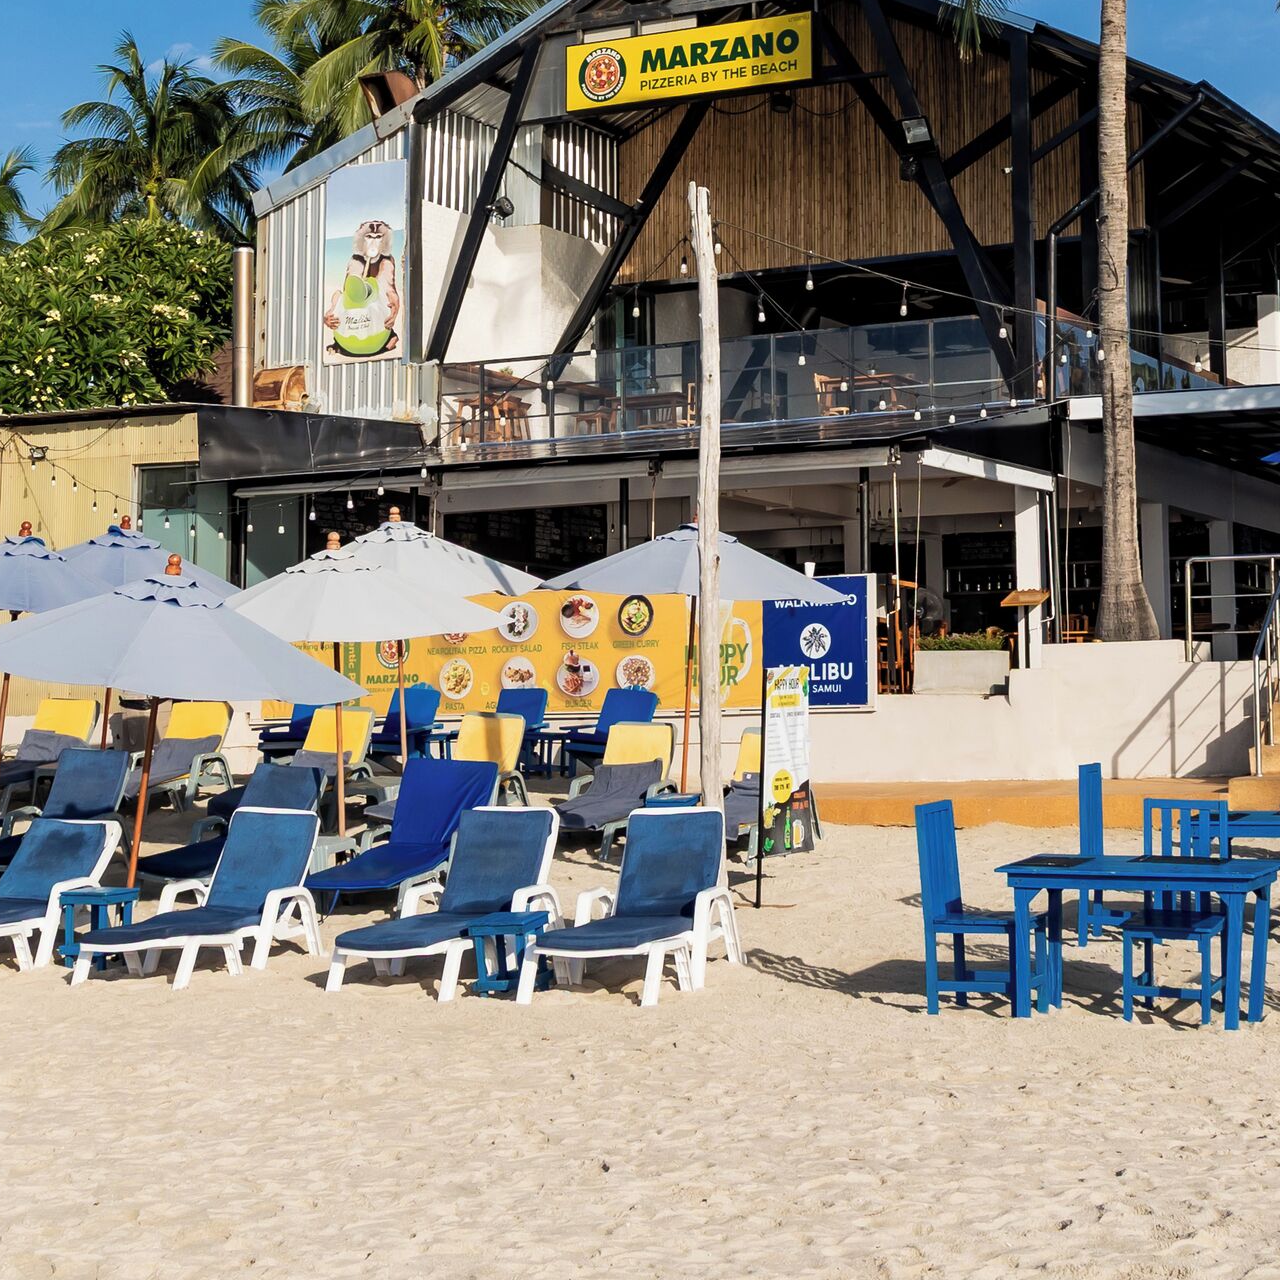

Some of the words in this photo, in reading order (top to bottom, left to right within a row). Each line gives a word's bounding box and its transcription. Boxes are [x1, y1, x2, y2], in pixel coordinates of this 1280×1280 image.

[586, 48, 621, 63] MARZANO
[640, 28, 800, 73] MARZANO
[640, 73, 697, 91] PIZZERIA
[701, 71, 718, 83] BY
[722, 66, 748, 80] THE
[751, 59, 798, 76] BEACH
[561, 642, 576, 650] FISH
[578, 641, 599, 650] STEAK
[636, 639, 660, 648] CURRY
[469, 646, 487, 655] PIZZA
[491, 645, 518, 654] ROCKET
[520, 644, 542, 653] SALAD
[685, 643, 749, 665] HPY
[778, 662, 853, 681] LIBU
[812, 684, 842, 694] SAMUI
[445, 702, 465, 710] PASTA
[565, 699, 592, 708] BURGER
